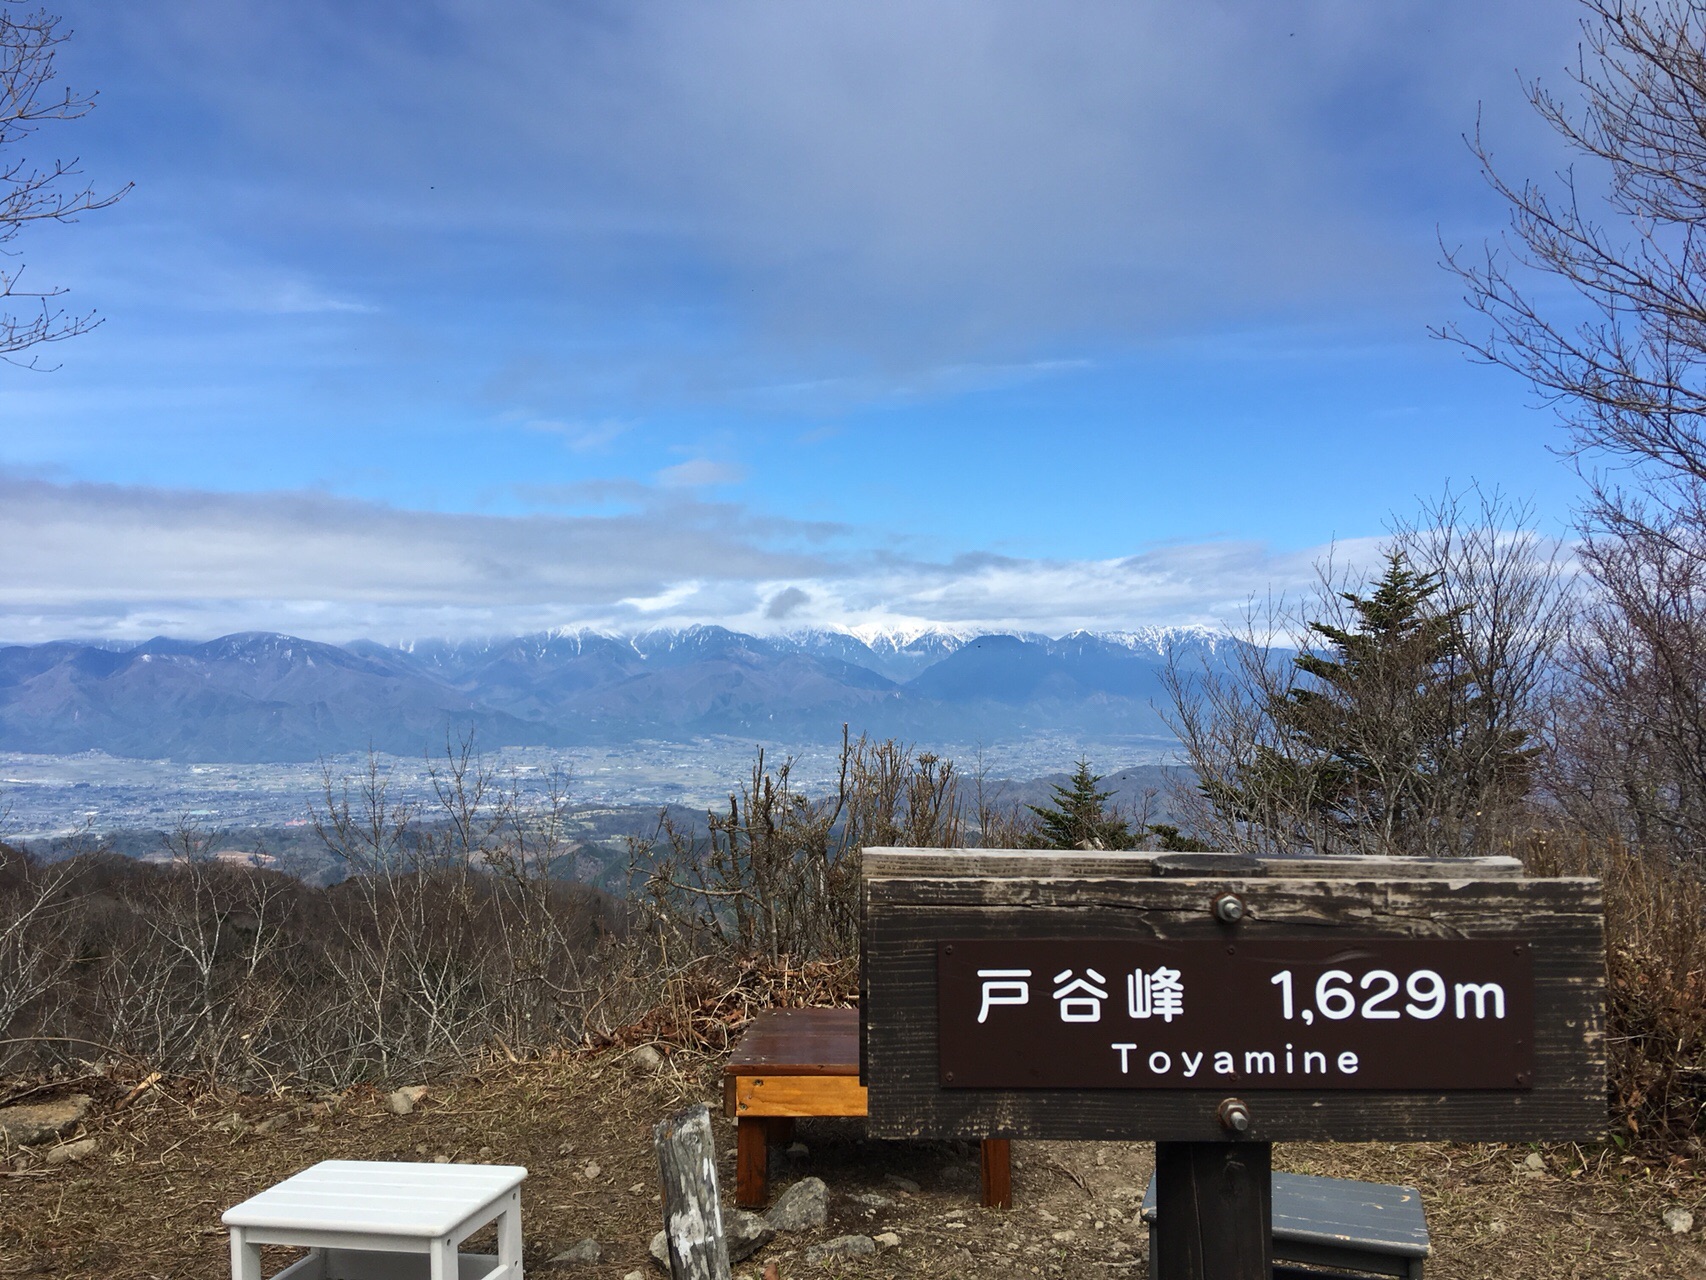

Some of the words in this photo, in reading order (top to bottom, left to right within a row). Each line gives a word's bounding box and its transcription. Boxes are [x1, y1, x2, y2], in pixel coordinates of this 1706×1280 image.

[975, 965, 1186, 1024] 戸谷峰
[1270, 969, 1506, 1026] 1,629m
[1111, 1043, 1359, 1078] Toyamine
